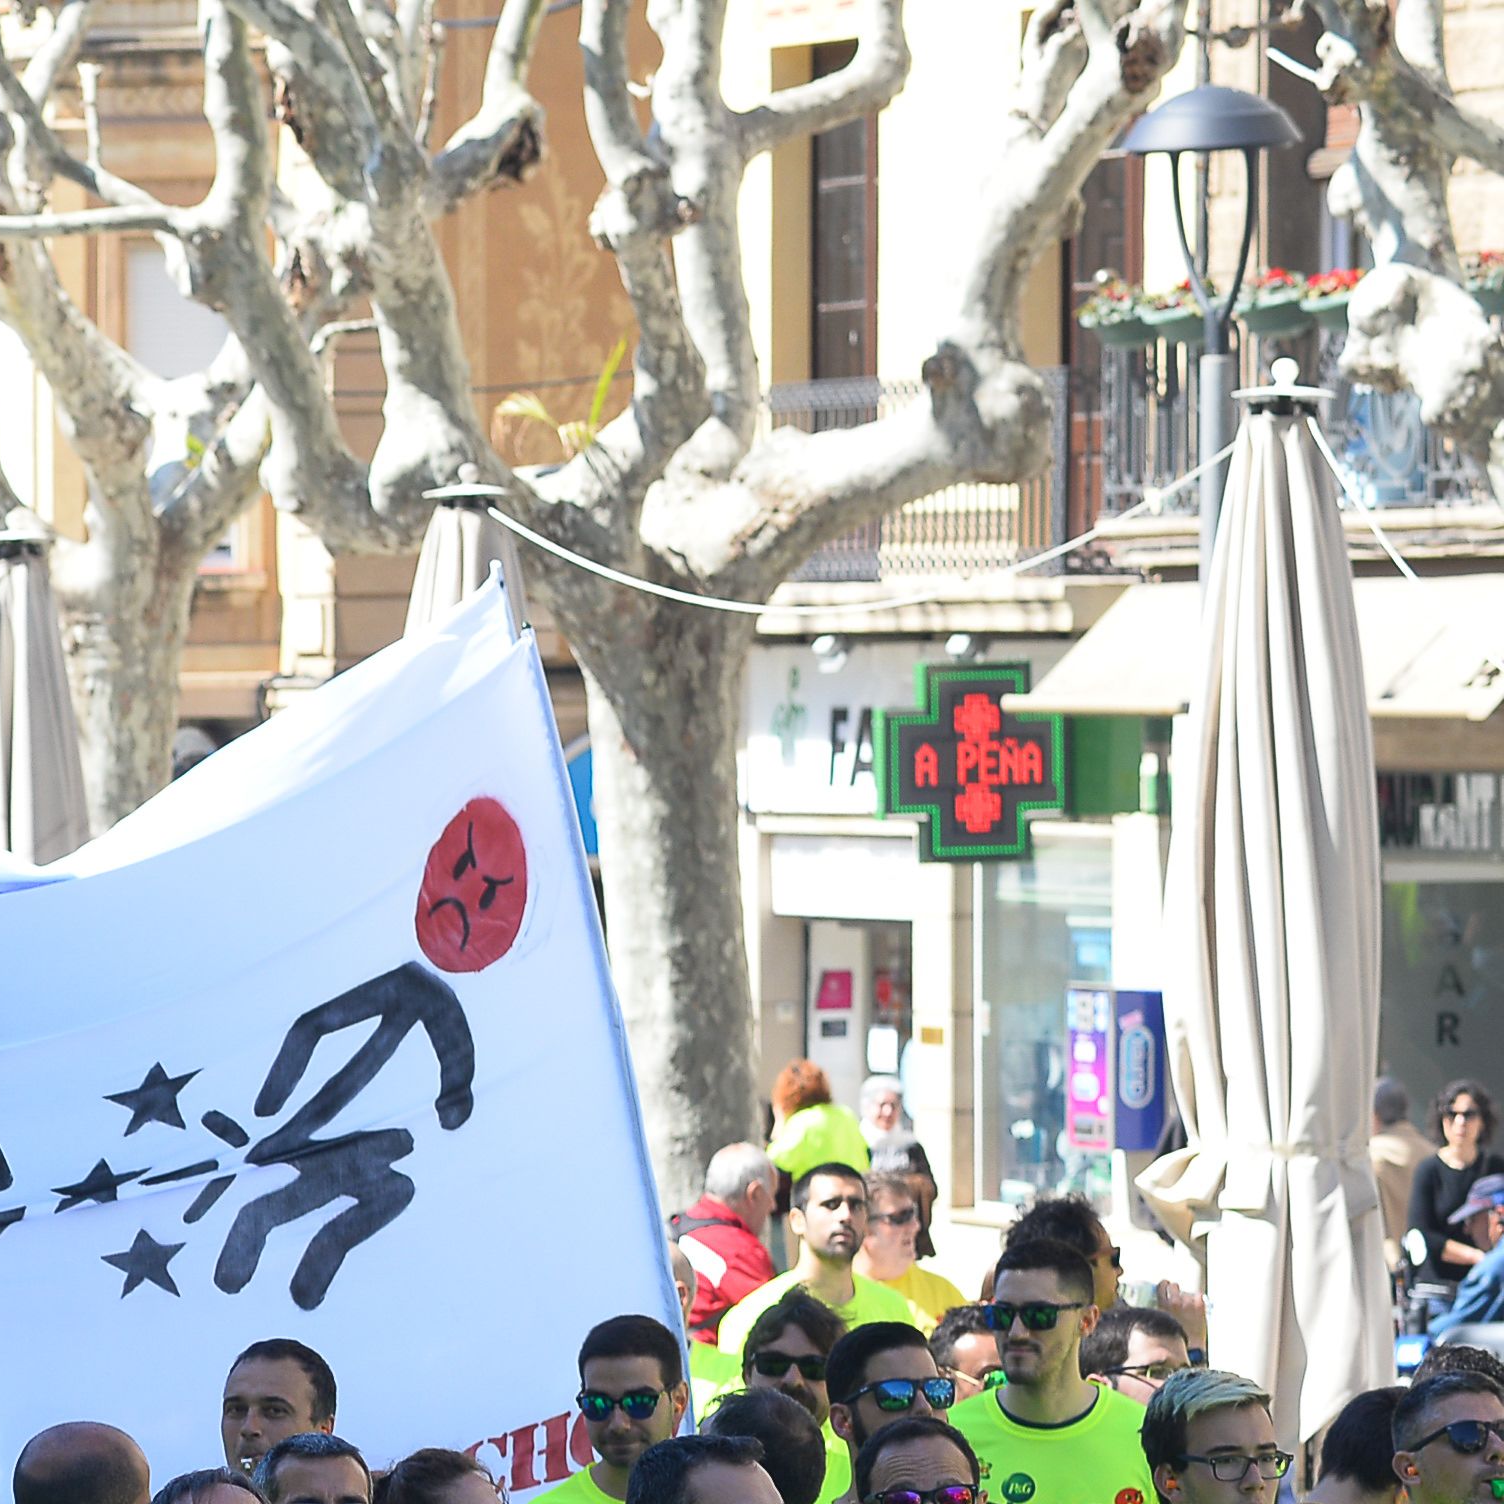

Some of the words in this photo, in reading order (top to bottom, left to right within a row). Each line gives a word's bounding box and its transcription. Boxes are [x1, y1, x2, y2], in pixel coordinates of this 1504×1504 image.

[914, 742, 939, 788] A
[956, 736, 1043, 786] PEÑA
[1008, 1481, 1032, 1495] P&G
